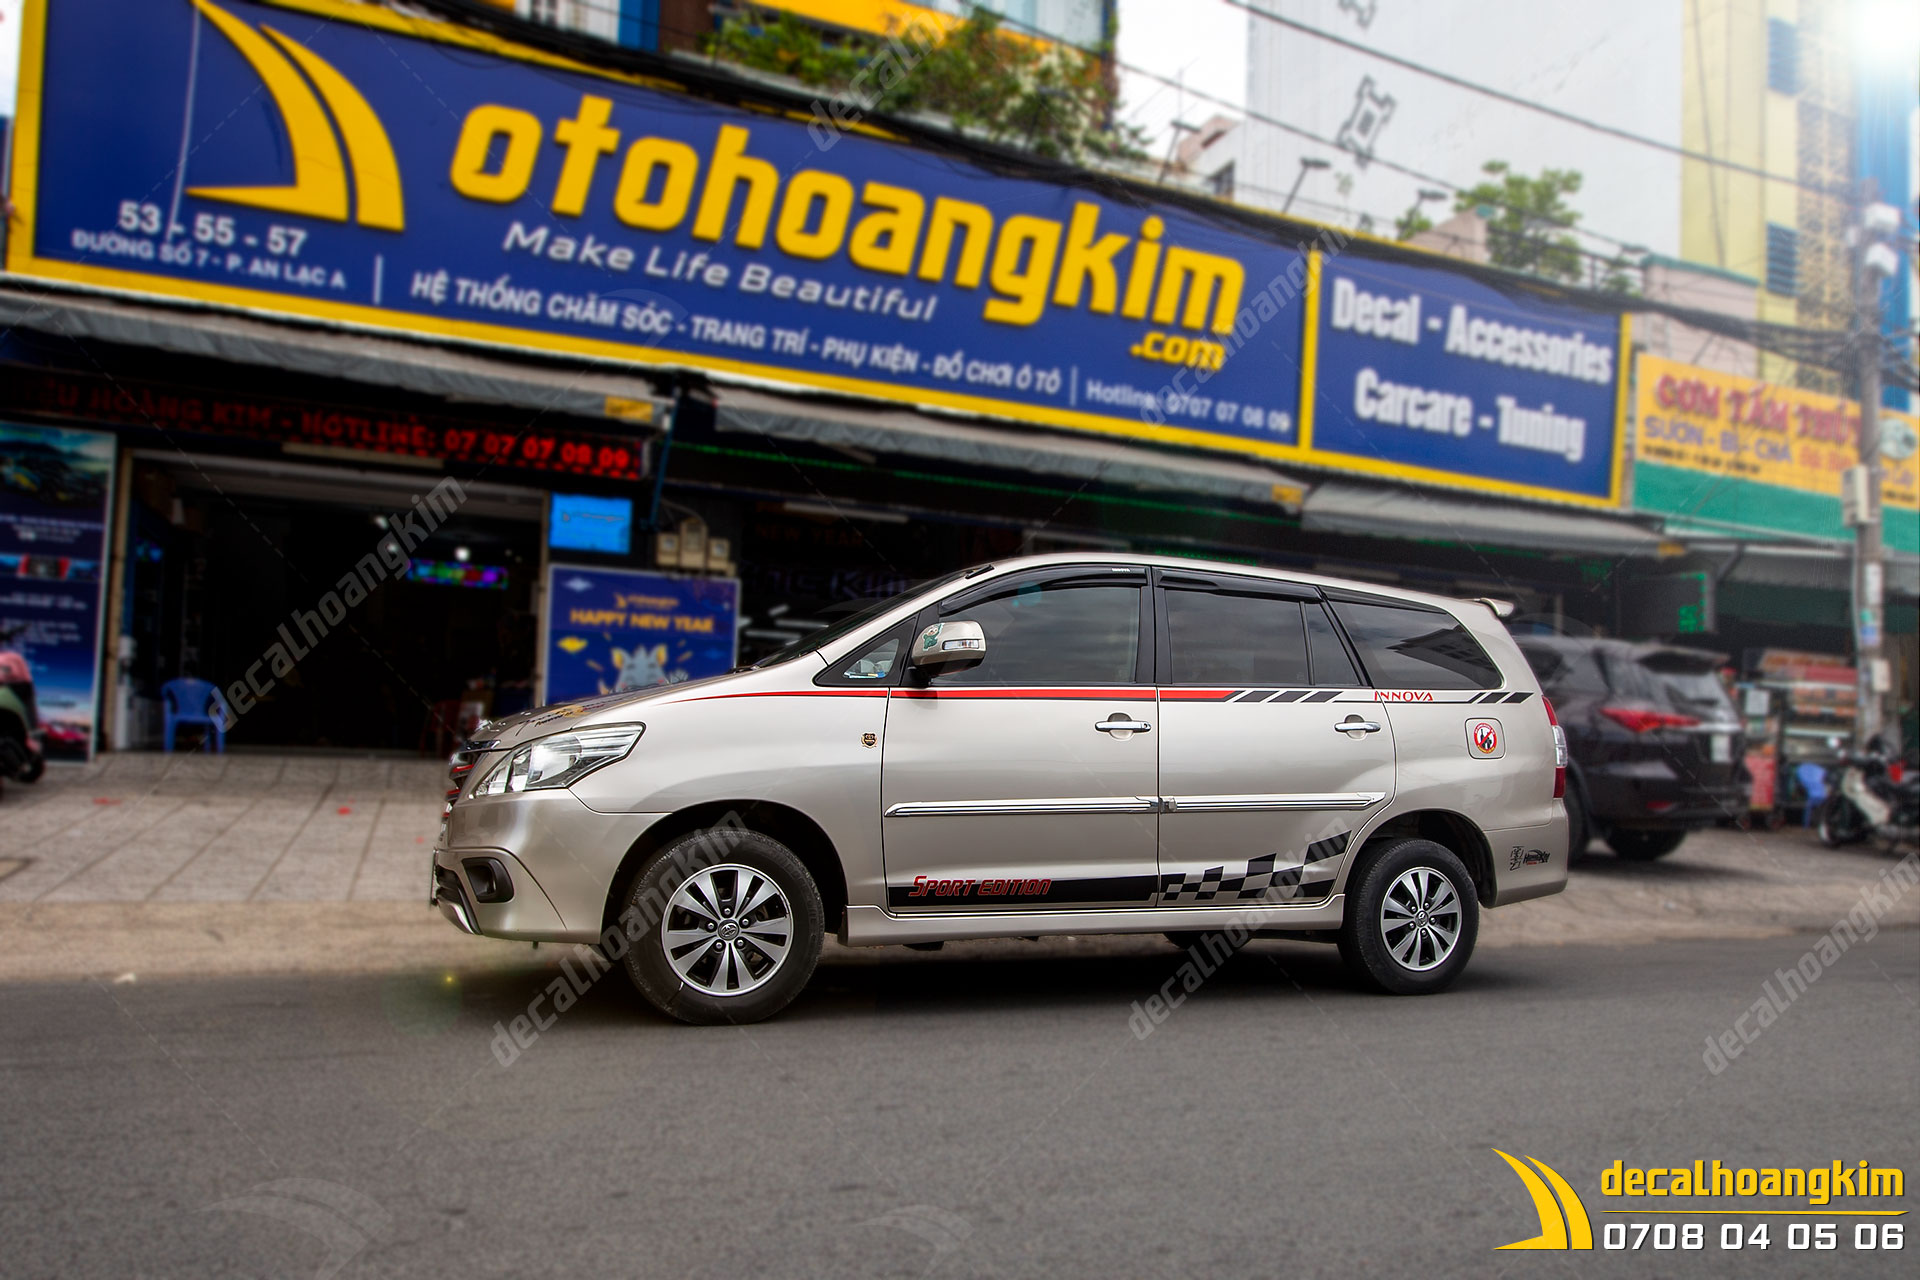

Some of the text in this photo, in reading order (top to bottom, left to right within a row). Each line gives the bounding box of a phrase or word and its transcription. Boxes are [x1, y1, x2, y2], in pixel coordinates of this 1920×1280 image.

[118, 200, 161, 234] 53
[194, 212, 235, 247] 55
[267, 224, 307, 256] 57
[450, 94, 1246, 334] otohoangkim
[196, 249, 209, 267] 7
[330, 270, 346, 288] A
[503, 220, 938, 322] Make Life Beautiful
[411, 269, 449, 306] HỆ
[621, 301, 674, 335] SÓC
[690, 316, 766, 349] TRANG
[771, 326, 810, 355] TRÍ
[821, 335, 868, 369] PHỤ
[869, 343, 919, 376] KIỆN
[1331, 277, 1421, 345] Decal
[1445, 304, 1613, 385] Accessories
[1130, 330, 1226, 372] .com
[1215, 400, 1240, 423] 07
[1354, 367, 1474, 437] Carcare
[1496, 395, 1587, 463] Tuning
[445, 428, 477, 451] 07
[483, 432, 516, 456] 07
[522, 436, 556, 460] 07
[599, 446, 631, 470] 09
[570, 608, 714, 633] HAPPY NEW YEAR
[1374, 690, 1434, 703] INNOVA
